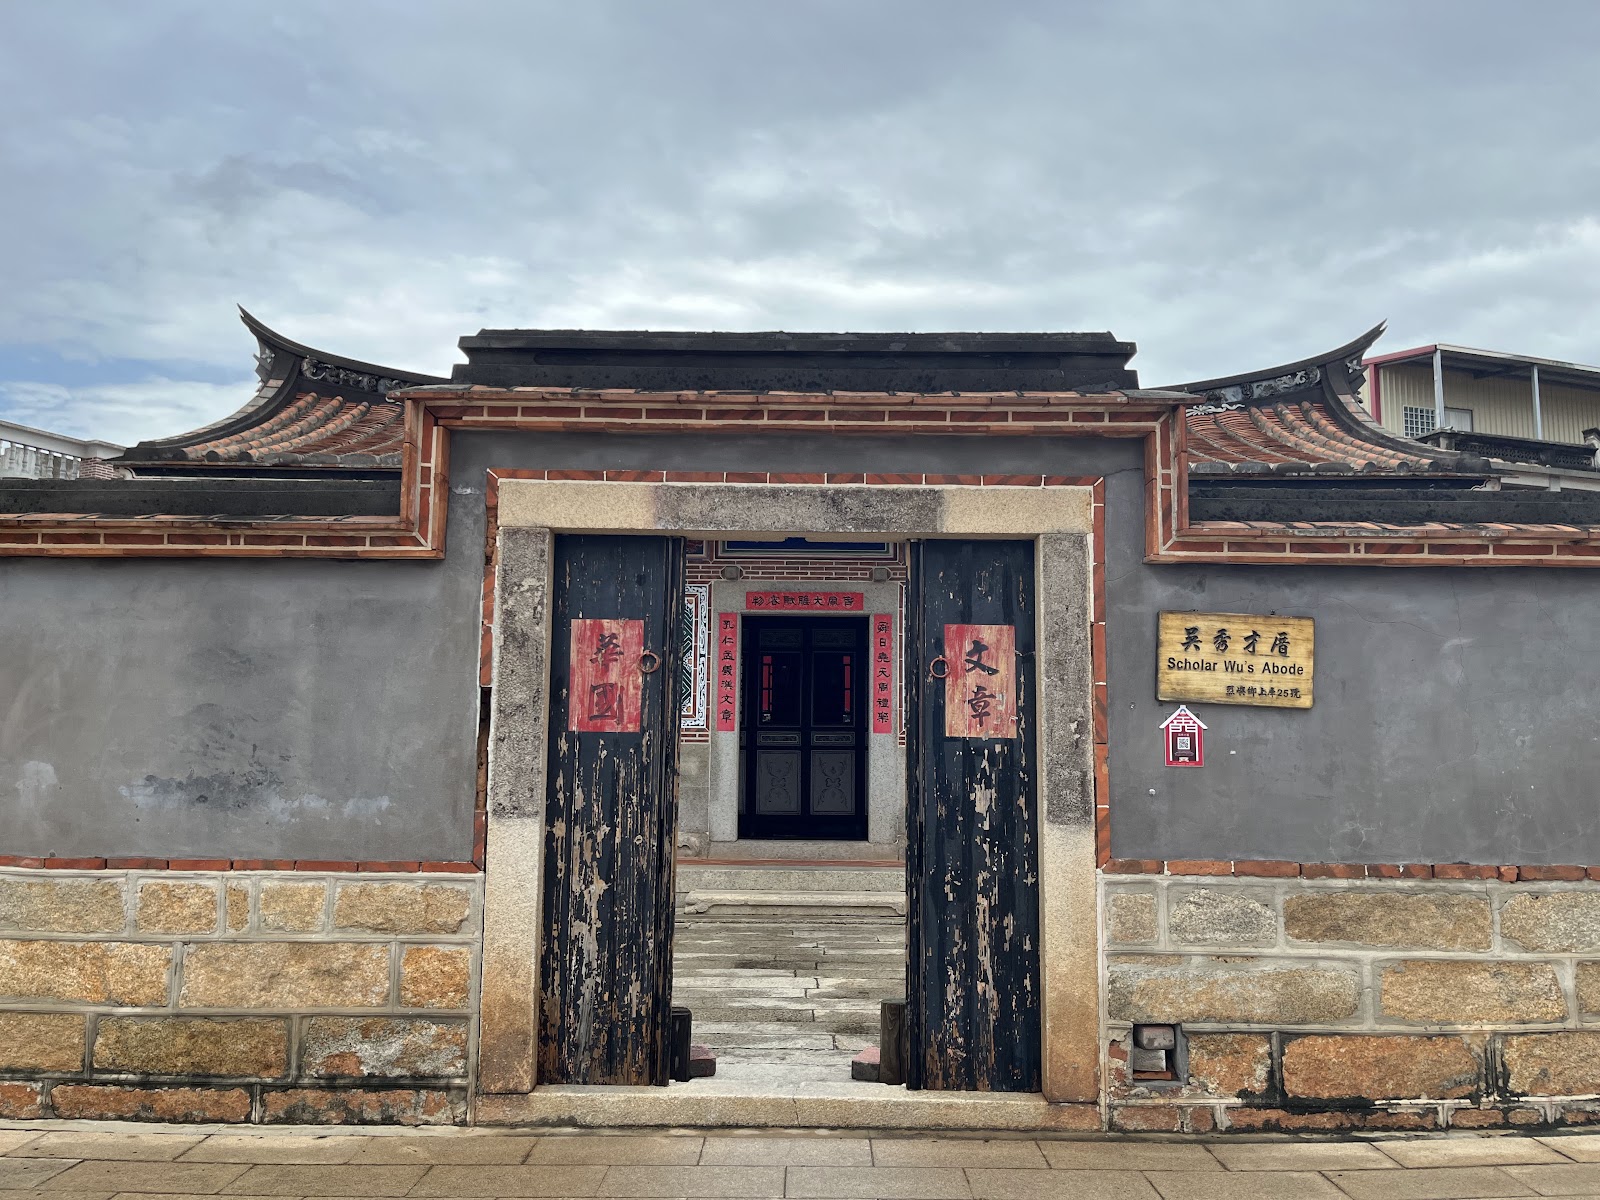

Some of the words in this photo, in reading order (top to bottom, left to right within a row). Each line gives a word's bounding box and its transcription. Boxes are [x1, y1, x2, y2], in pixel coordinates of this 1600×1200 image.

[1180, 627, 1291, 658] 吳秀才厝
[1167, 657, 1218, 672] Scholar
[1224, 660, 1255, 674] Wu's
[1261, 661, 1304, 676] Abode
[964, 639, 1000, 728] 文章
